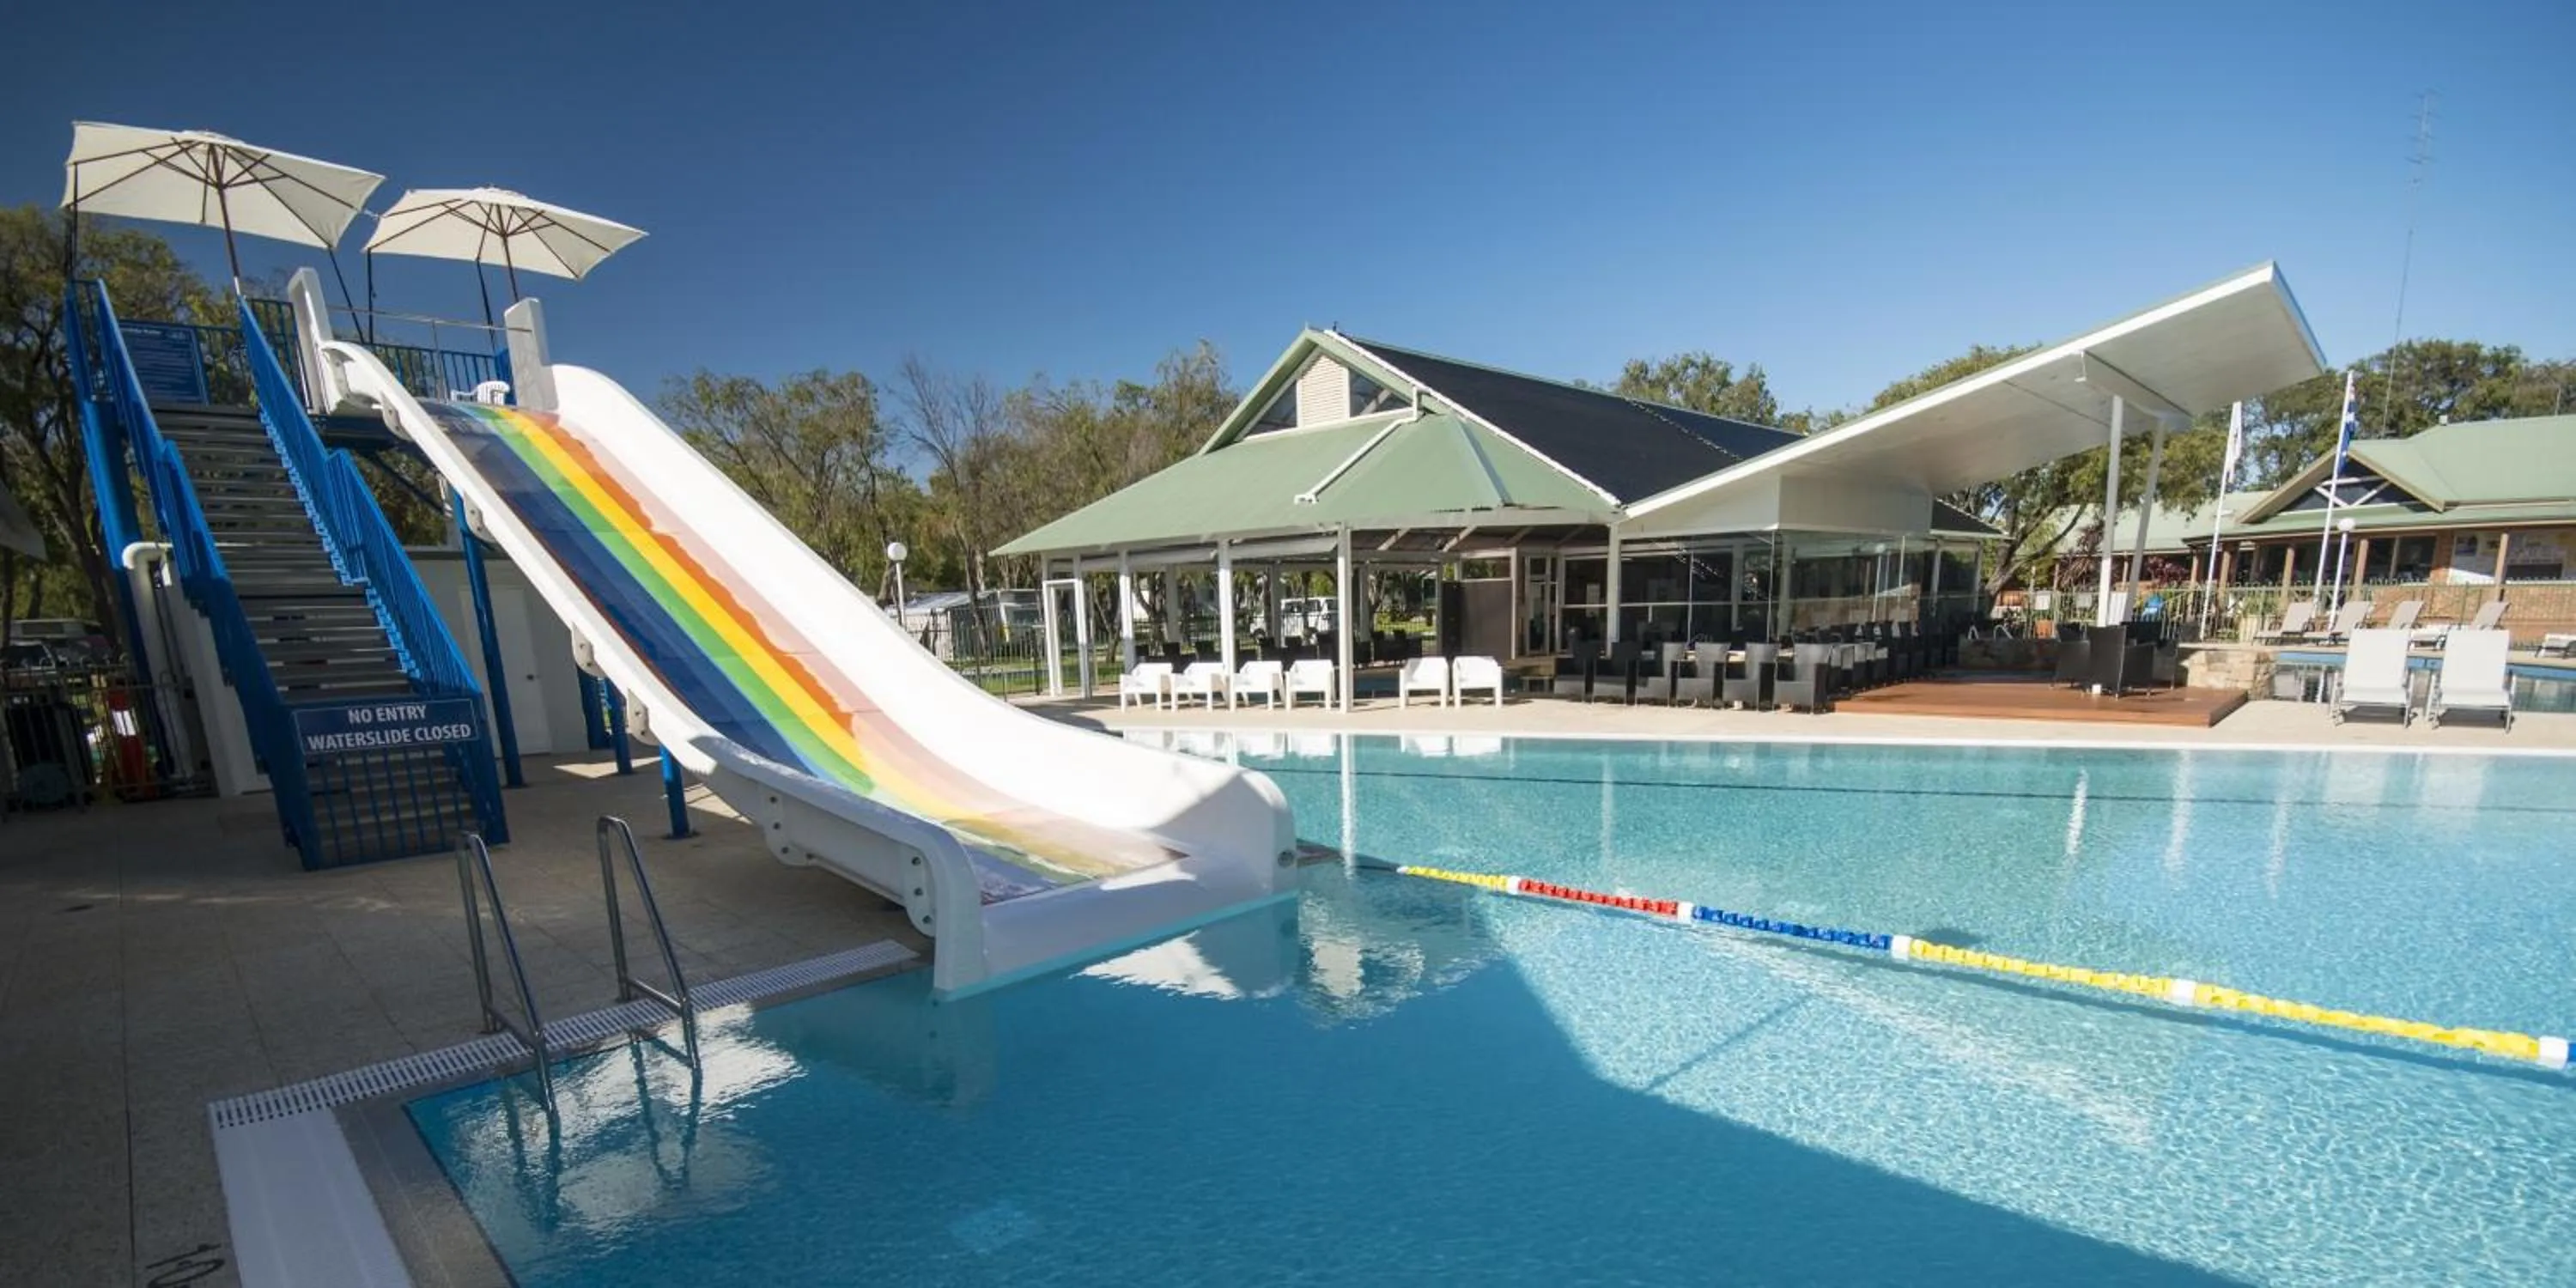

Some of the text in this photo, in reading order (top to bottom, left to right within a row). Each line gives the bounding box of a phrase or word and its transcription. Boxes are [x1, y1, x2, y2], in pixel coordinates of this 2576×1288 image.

[348, 704, 427, 724] NO ENTRY
[307, 724, 471, 750] WATERSLIDE CLOSED
